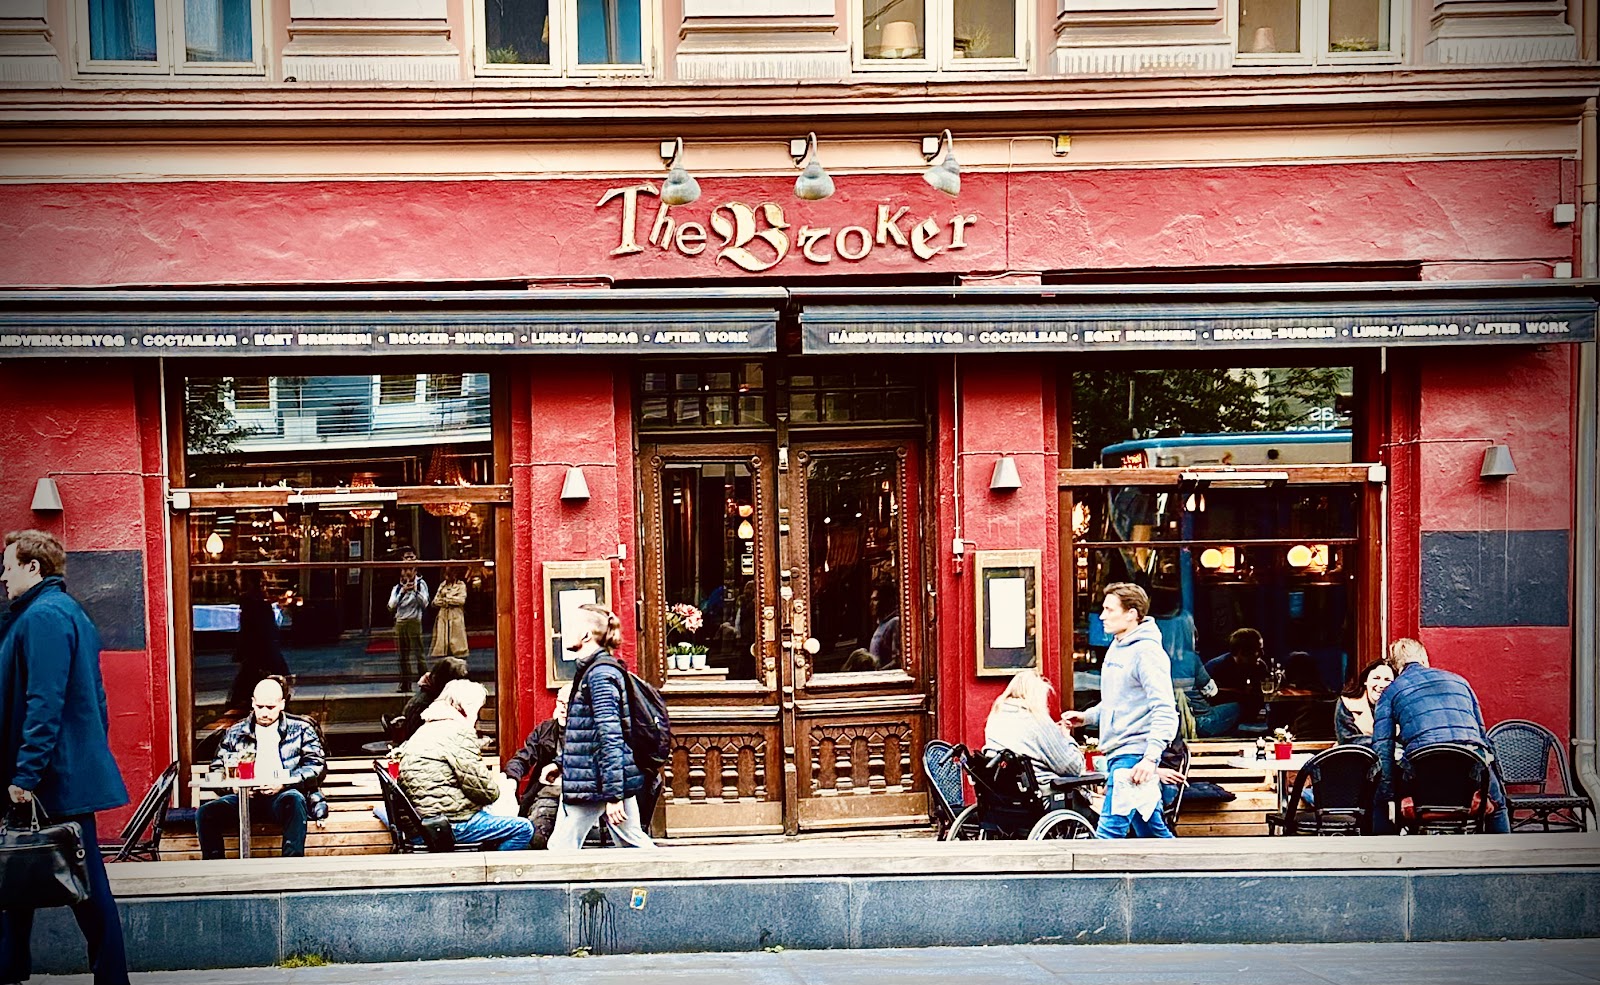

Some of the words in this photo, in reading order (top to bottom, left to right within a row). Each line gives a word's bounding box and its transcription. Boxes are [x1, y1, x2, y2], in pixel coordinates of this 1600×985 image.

[596, 182, 707, 255] The
[710, 200, 978, 271] Broker
[0, 334, 125, 347] NDVERKSBRYGG
[142, 334, 237, 347] COCTAILBAR
[388, 332, 515, 345] BROKER-BURGER
[531, 331, 639, 344] LUNSJ/MIDDAG
[654, 331, 700, 343] AFTER
[704, 331, 749, 343] WORK
[828, 329, 964, 344] HÅNDVERKSBRYGG
[979, 331, 1068, 344] COCTAILBAR
[1213, 327, 1336, 341] BROKER-BURGER
[1352, 323, 1459, 338] LUNSJ/MIDDAG
[1474, 322, 1521, 335] AFTER
[1525, 321, 1570, 334] WORK
